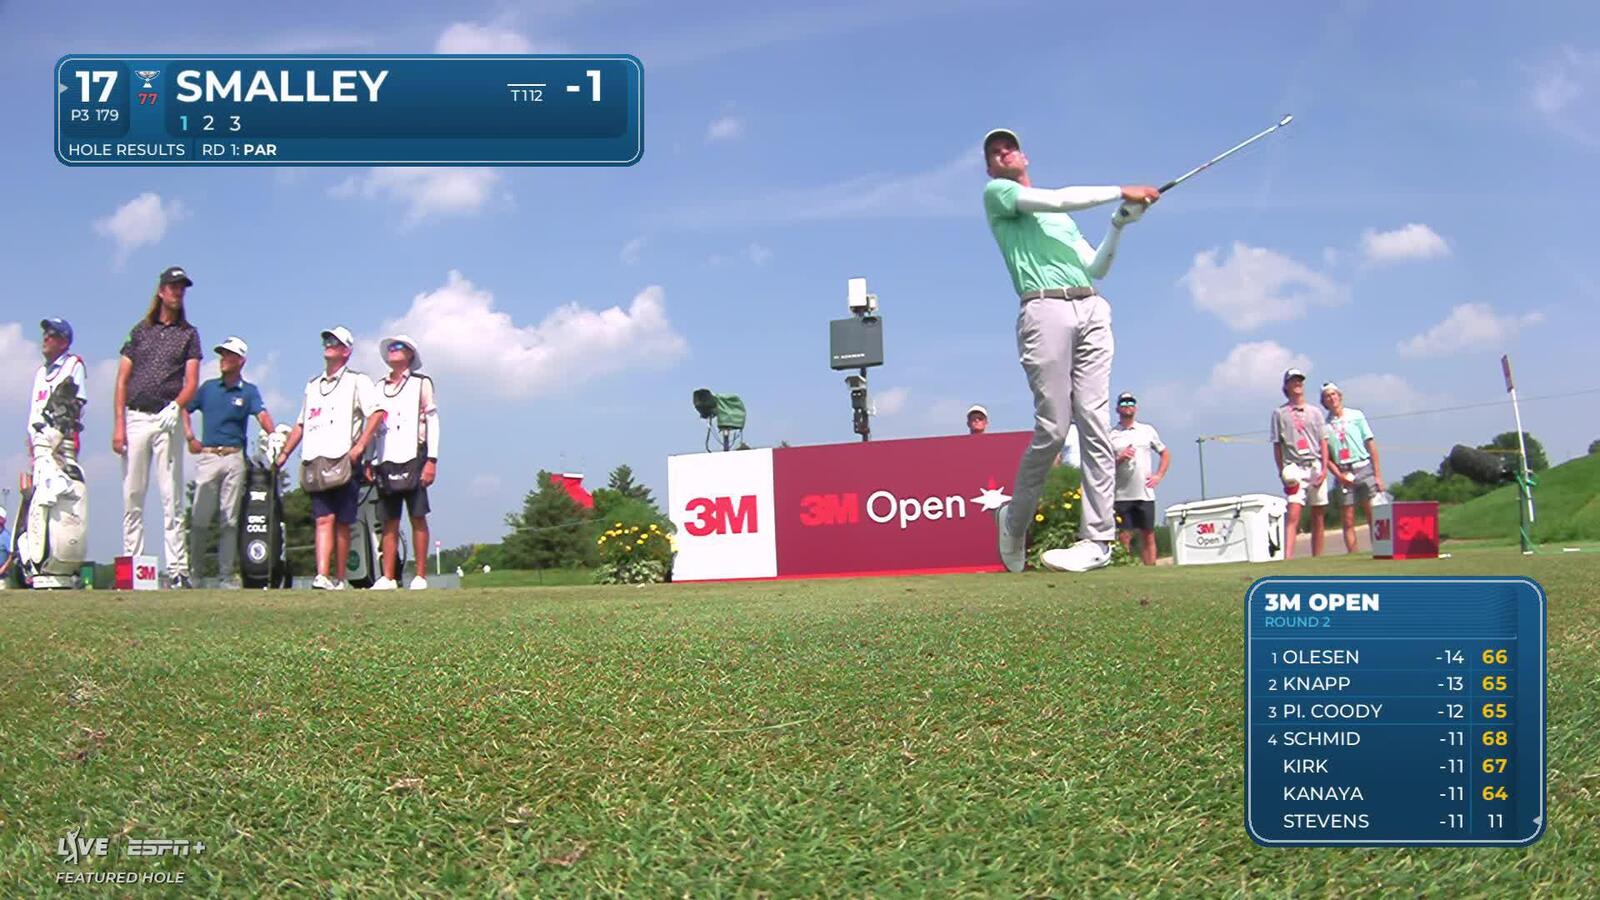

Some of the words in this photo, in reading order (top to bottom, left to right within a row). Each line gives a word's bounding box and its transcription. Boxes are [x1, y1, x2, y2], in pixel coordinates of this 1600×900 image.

[683, 494, 760, 537] 3M
[799, 493, 860, 528] 3M
[866, 490, 967, 529] Open
[1196, 522, 1215, 535] 3M
[1374, 518, 1391, 541] 3M
[1397, 516, 1434, 541] 3M
[136, 564, 156, 580] 3M
